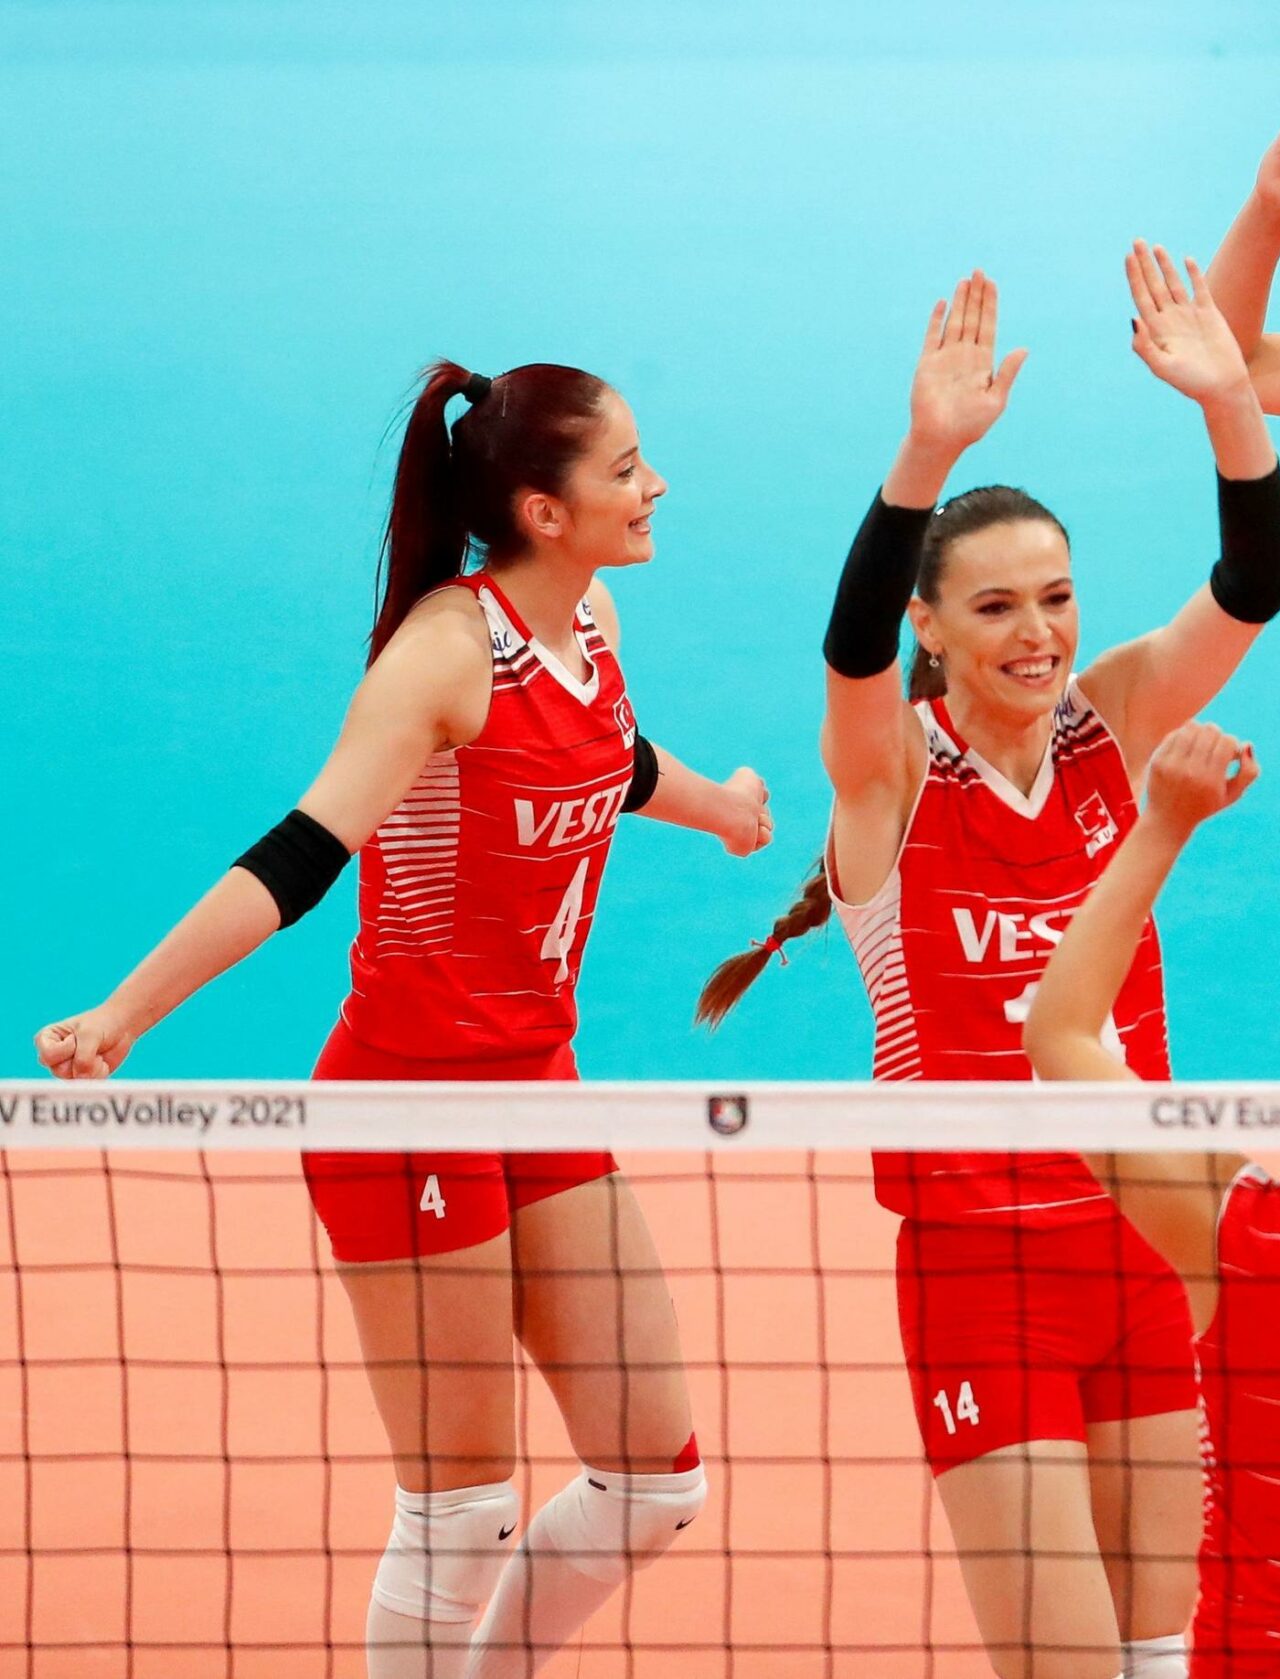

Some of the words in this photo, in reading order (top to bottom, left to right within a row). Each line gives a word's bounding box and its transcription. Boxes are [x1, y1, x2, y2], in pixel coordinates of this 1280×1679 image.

[540, 856, 591, 985] 4
[952, 906, 1084, 964] VES
[30, 1095, 218, 1133] EuroVolley
[229, 1096, 307, 1127] 2021
[1150, 1096, 1226, 1128] CEV
[419, 1173, 447, 1219] 4
[932, 1380, 980, 1436] 14
